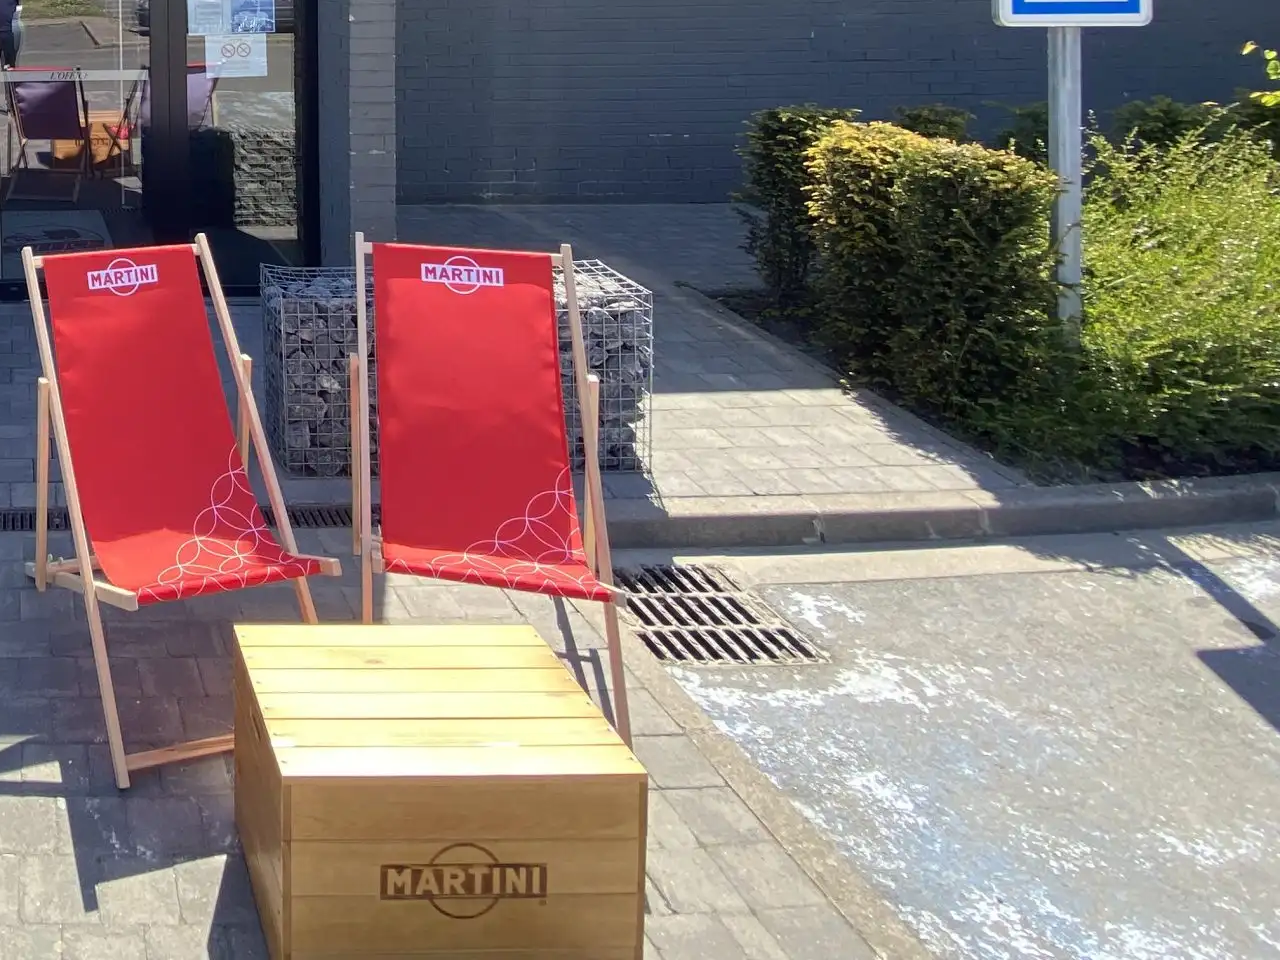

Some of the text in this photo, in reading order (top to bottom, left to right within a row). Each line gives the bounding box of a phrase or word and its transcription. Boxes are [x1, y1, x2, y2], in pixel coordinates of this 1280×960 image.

[90, 266, 156, 288] MARTINI
[424, 265, 502, 284] MARTINI
[386, 866, 541, 896] MARTINI
